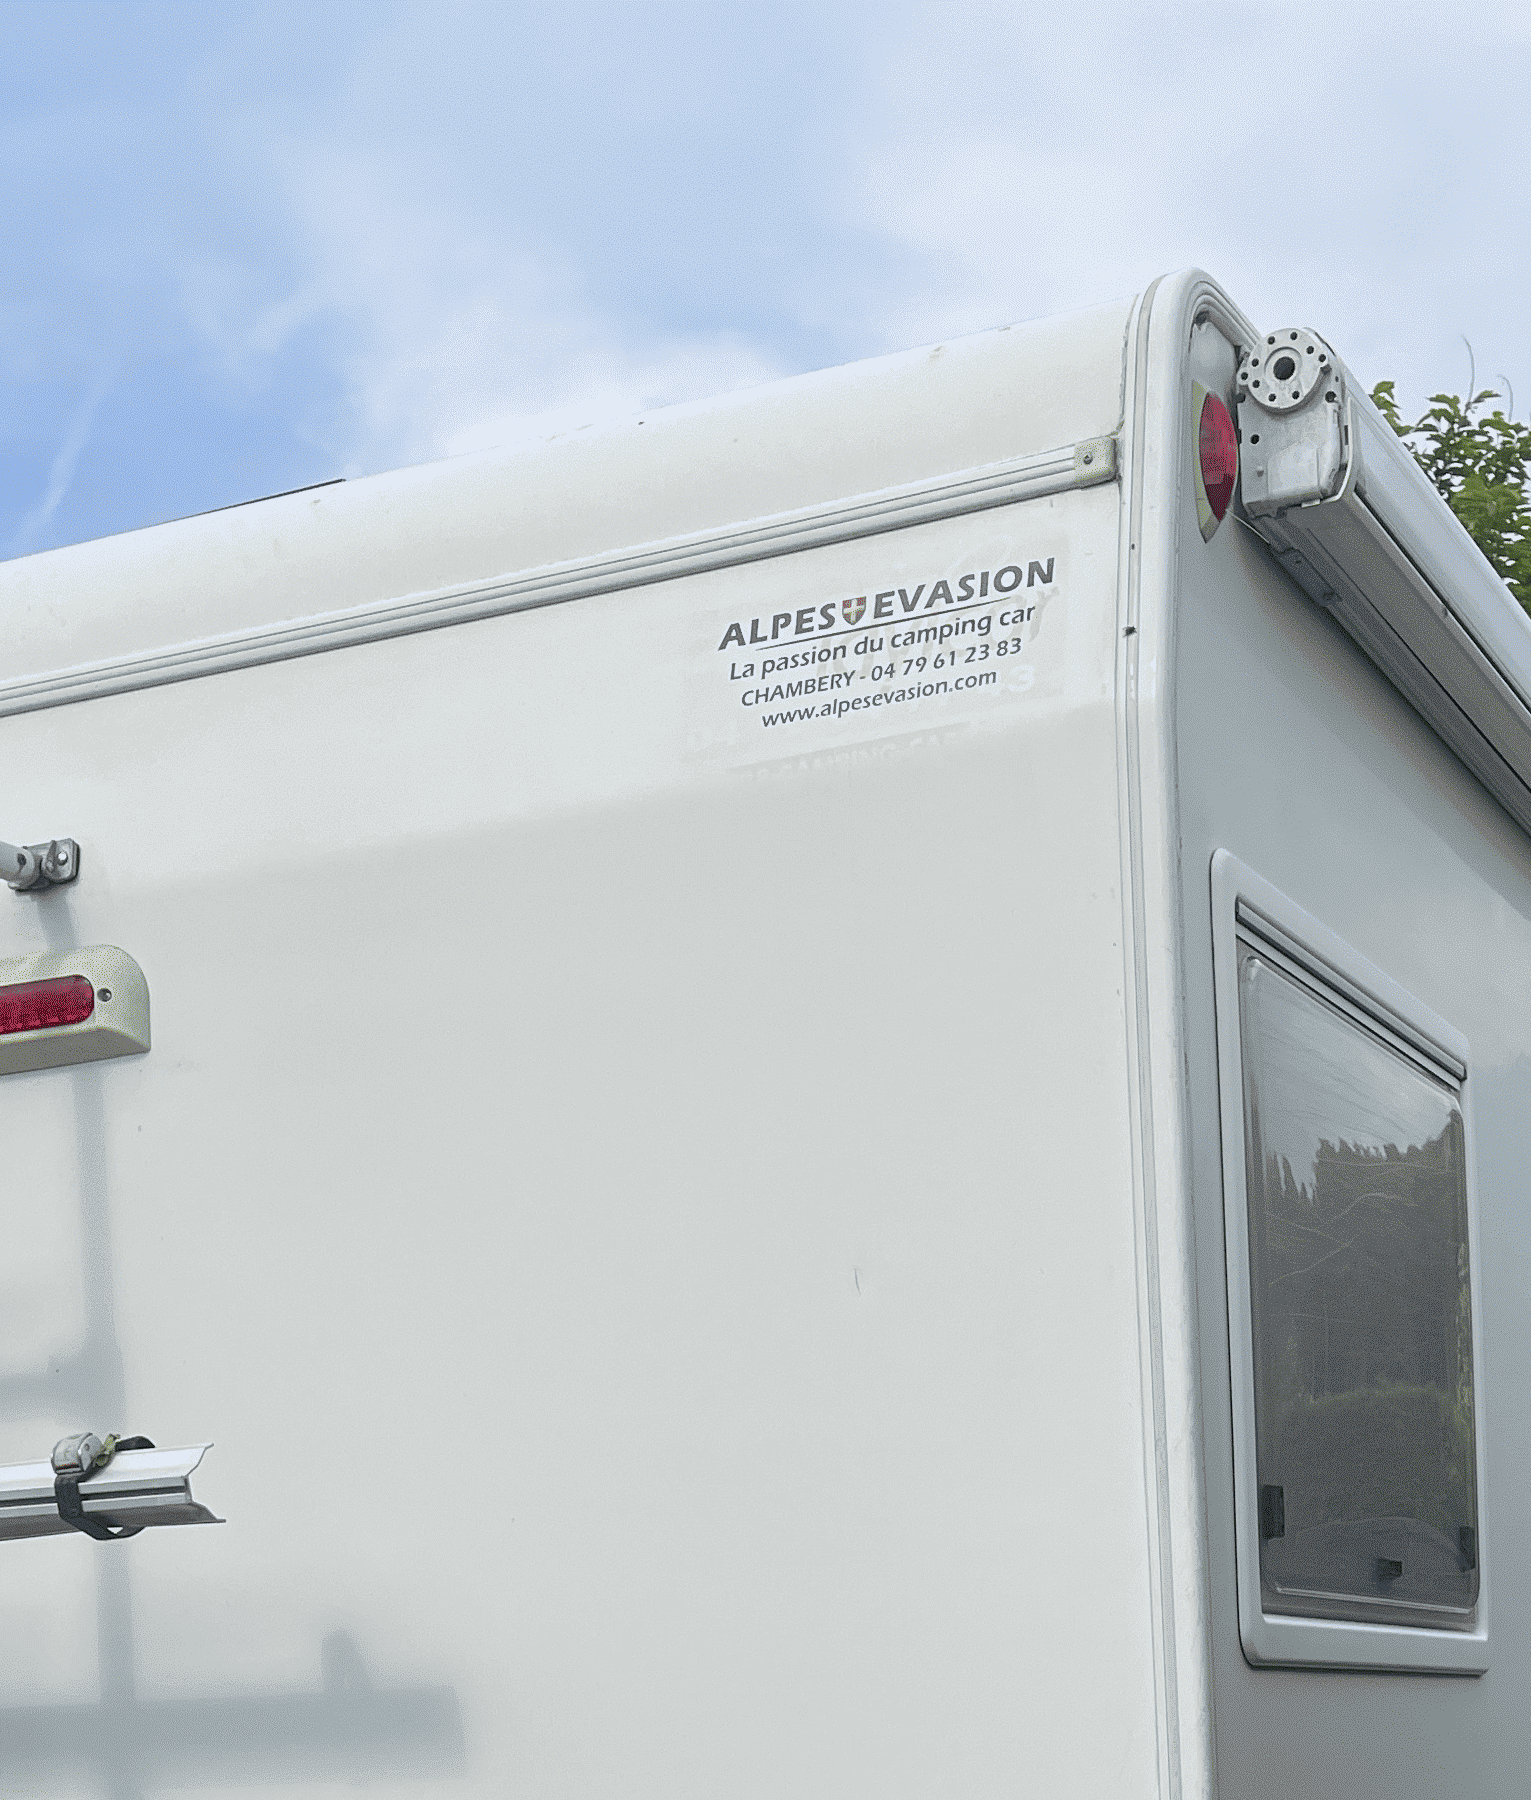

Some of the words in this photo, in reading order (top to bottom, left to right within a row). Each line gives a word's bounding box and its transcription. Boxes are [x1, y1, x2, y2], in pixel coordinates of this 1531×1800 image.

[718, 602, 836, 651] ALPES
[873, 557, 1055, 620] EVASION
[730, 662, 755, 681] La
[761, 645, 847, 680] passion
[854, 636, 884, 656] du
[891, 616, 992, 649] camping
[999, 606, 1036, 627] car
[741, 669, 856, 707] CHAMBERY
[871, 662, 897, 682] 04
[902, 656, 927, 676] 79
[933, 650, 956, 670] 61
[964, 643, 990, 664] 23
[996, 637, 1022, 657] 83
[762, 670, 998, 728] www.alpesevasion.com
